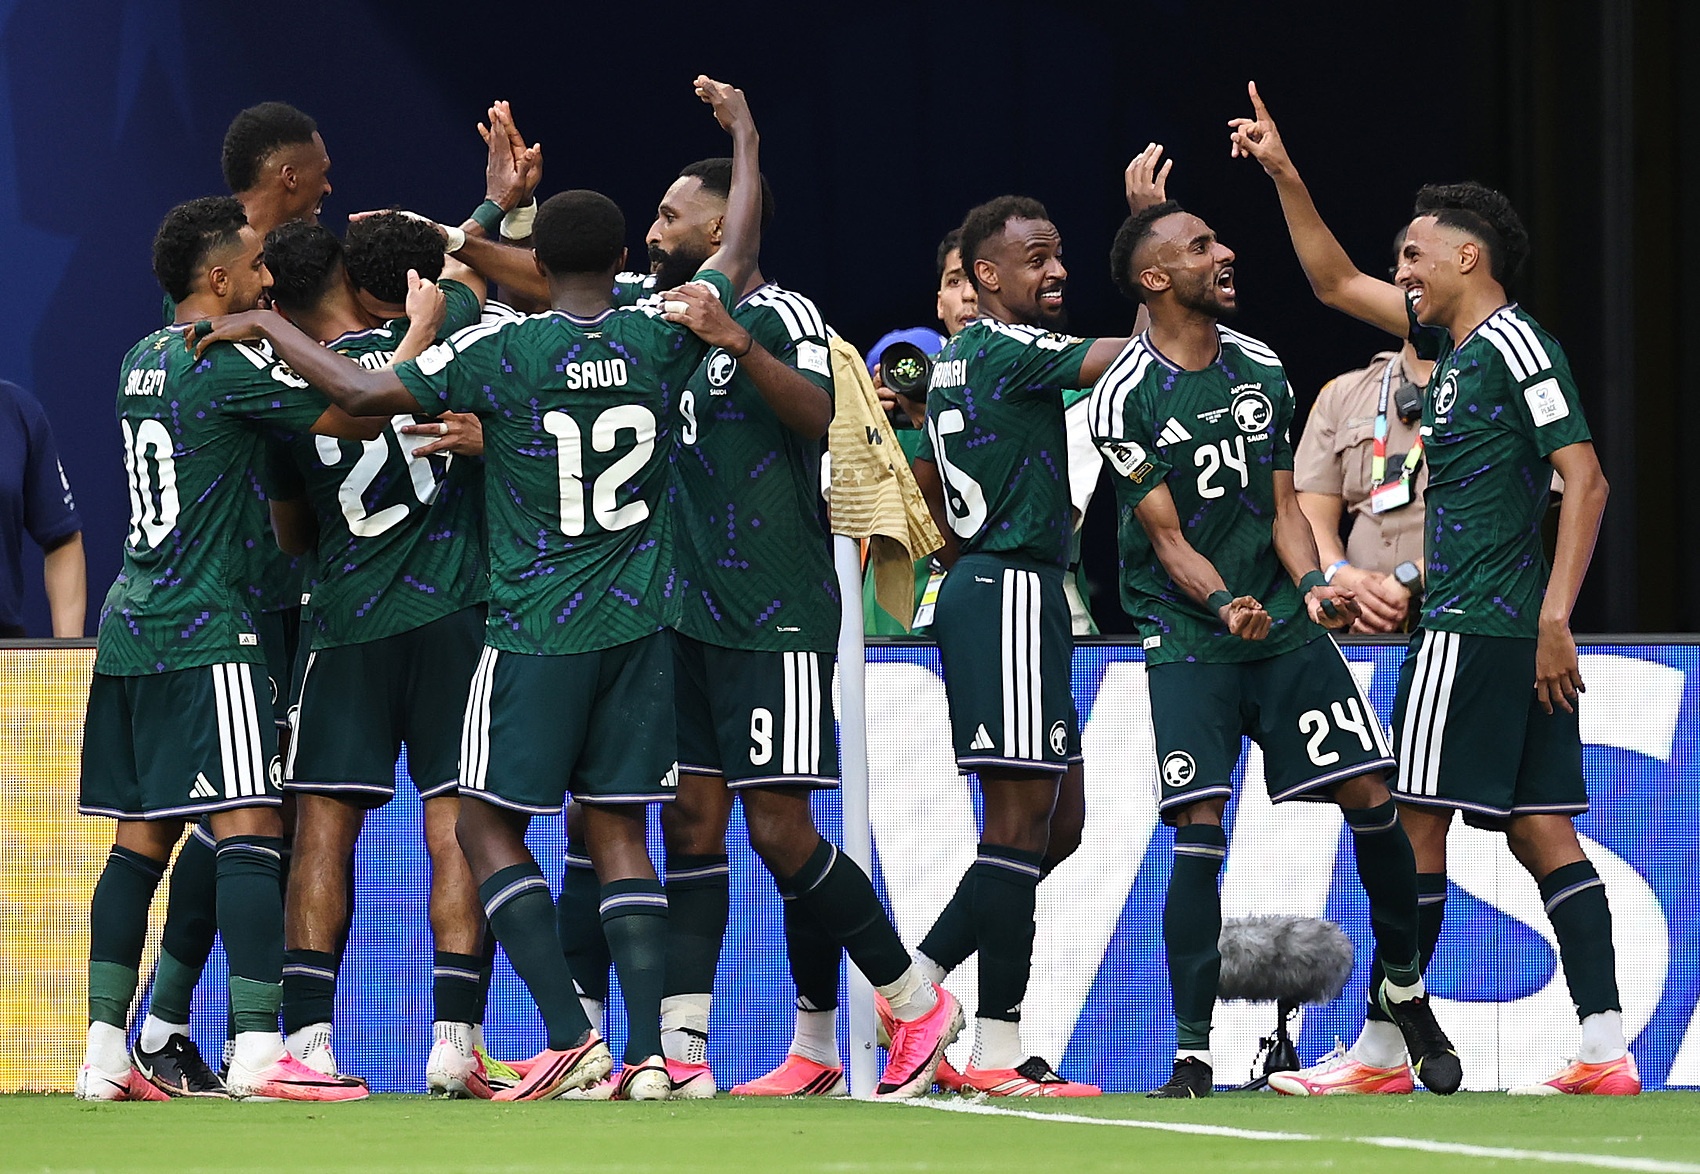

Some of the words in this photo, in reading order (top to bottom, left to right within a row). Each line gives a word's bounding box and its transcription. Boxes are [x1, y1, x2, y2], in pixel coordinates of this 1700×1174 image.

[125, 368, 167, 397] SALEM
[566, 359, 628, 390] SAUD
[679, 390, 697, 444] 9
[1246, 433, 1269, 443] SAUDI
[121, 418, 180, 549] 10
[542, 404, 656, 537] 12
[1194, 434, 1249, 499] 24
[749, 707, 773, 766] 9
[1298, 697, 1373, 767] 24
[831, 654, 1700, 1091] VIS
